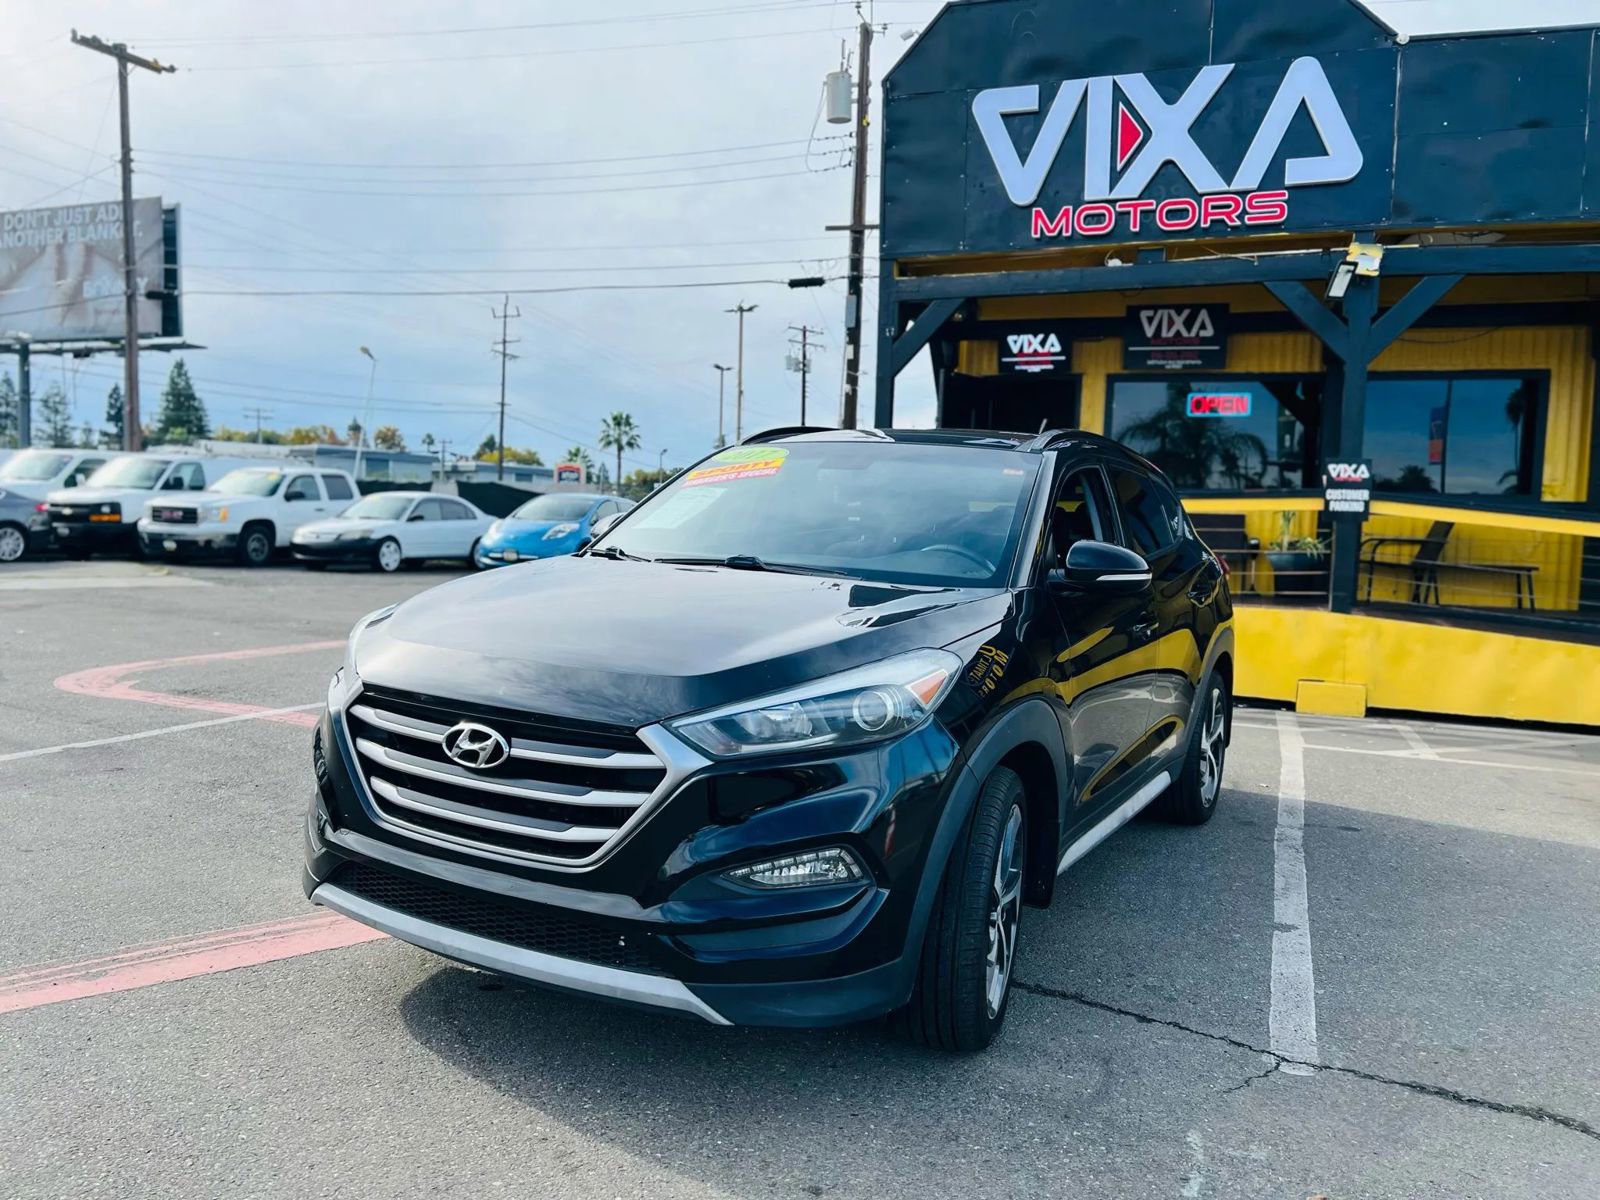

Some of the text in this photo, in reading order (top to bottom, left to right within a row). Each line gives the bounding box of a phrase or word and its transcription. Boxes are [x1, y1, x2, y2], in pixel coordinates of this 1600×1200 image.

[972, 56, 1364, 206] VIXA
[4, 211, 51, 230] DON'T
[53, 207, 93, 226] JUST
[1031, 190, 1288, 239] MOTORS
[1140, 308, 1215, 338] VIXA
[1007, 333, 1062, 353] VIXA
[1191, 395, 1248, 414] OPEN
[1327, 464, 1370, 478] VIXA
